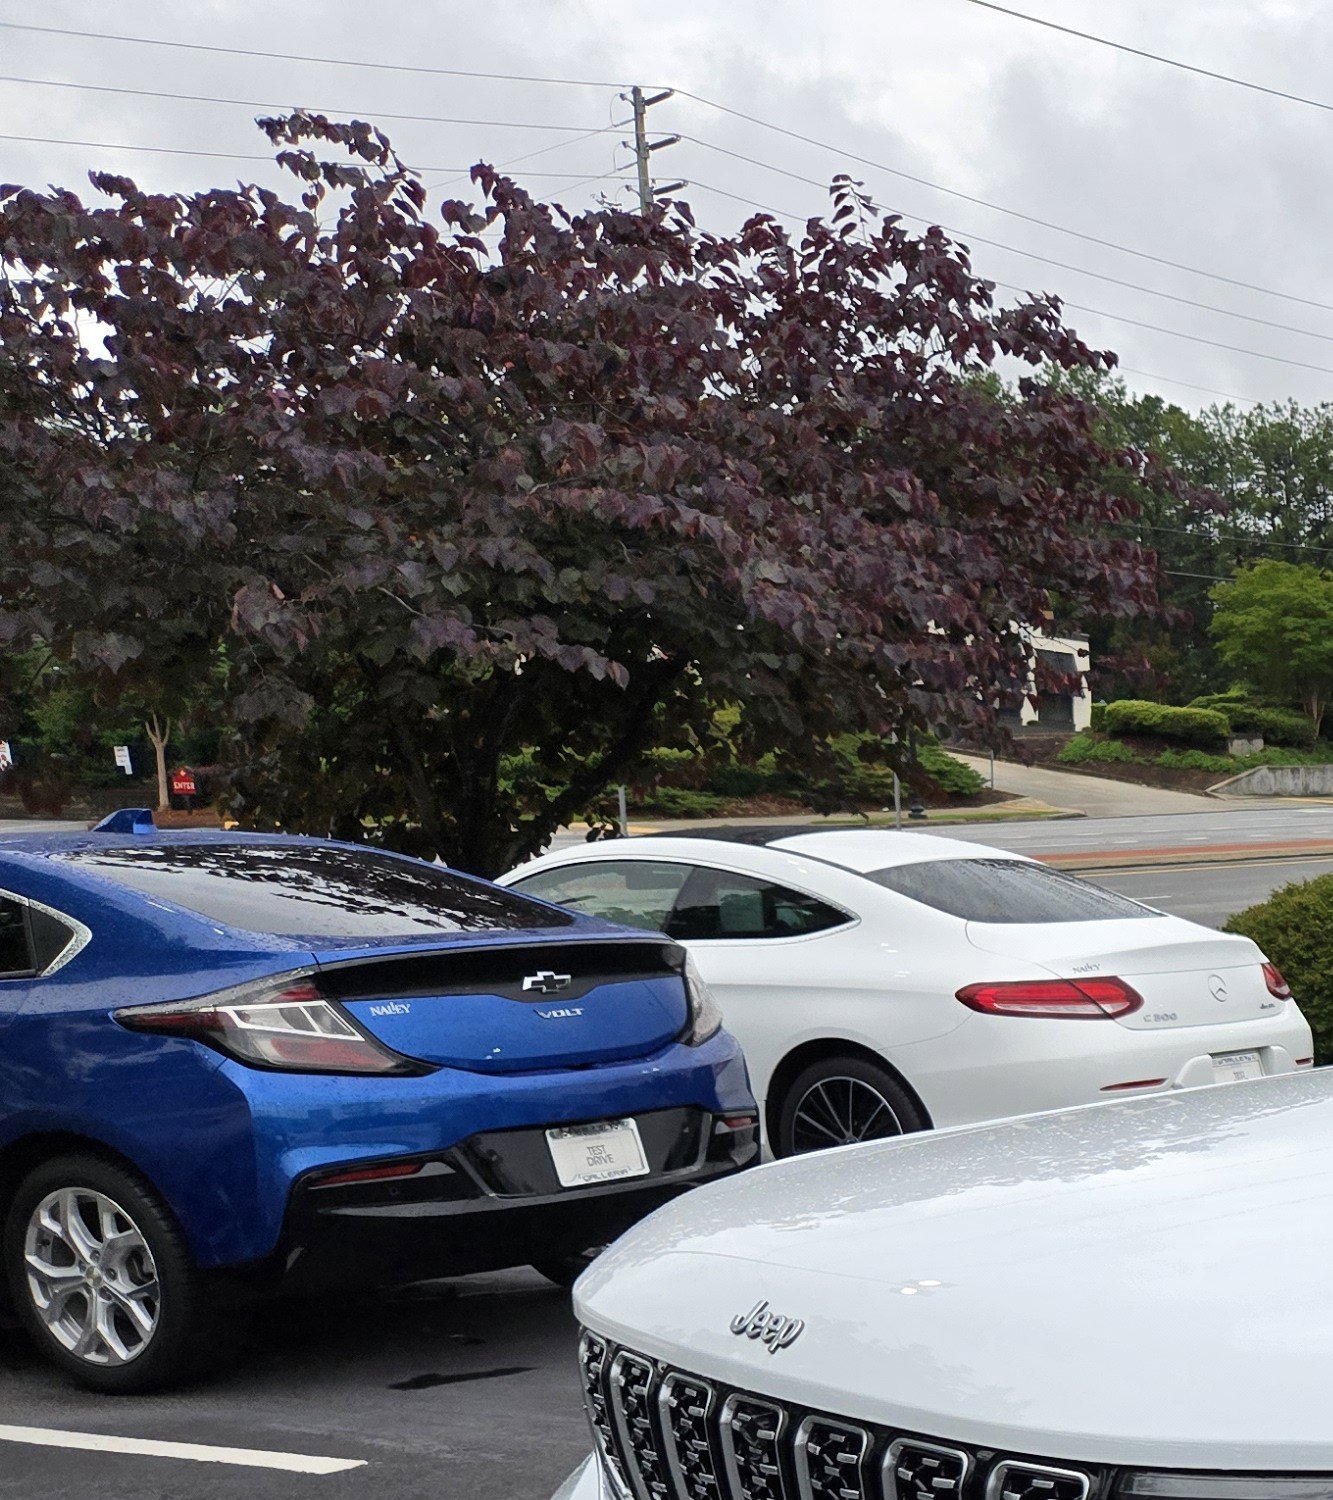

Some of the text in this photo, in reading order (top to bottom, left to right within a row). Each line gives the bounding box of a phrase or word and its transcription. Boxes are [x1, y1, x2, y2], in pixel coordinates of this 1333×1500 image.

[173, 781, 195, 790] ENTER
[370, 1001, 411, 1017] NALLEY
[533, 1007, 585, 1020] VOLT
[587, 1144, 606, 1156] TEST
[586, 1153, 615, 1167] DRIVE
[730, 1299, 805, 1355] Jeep
